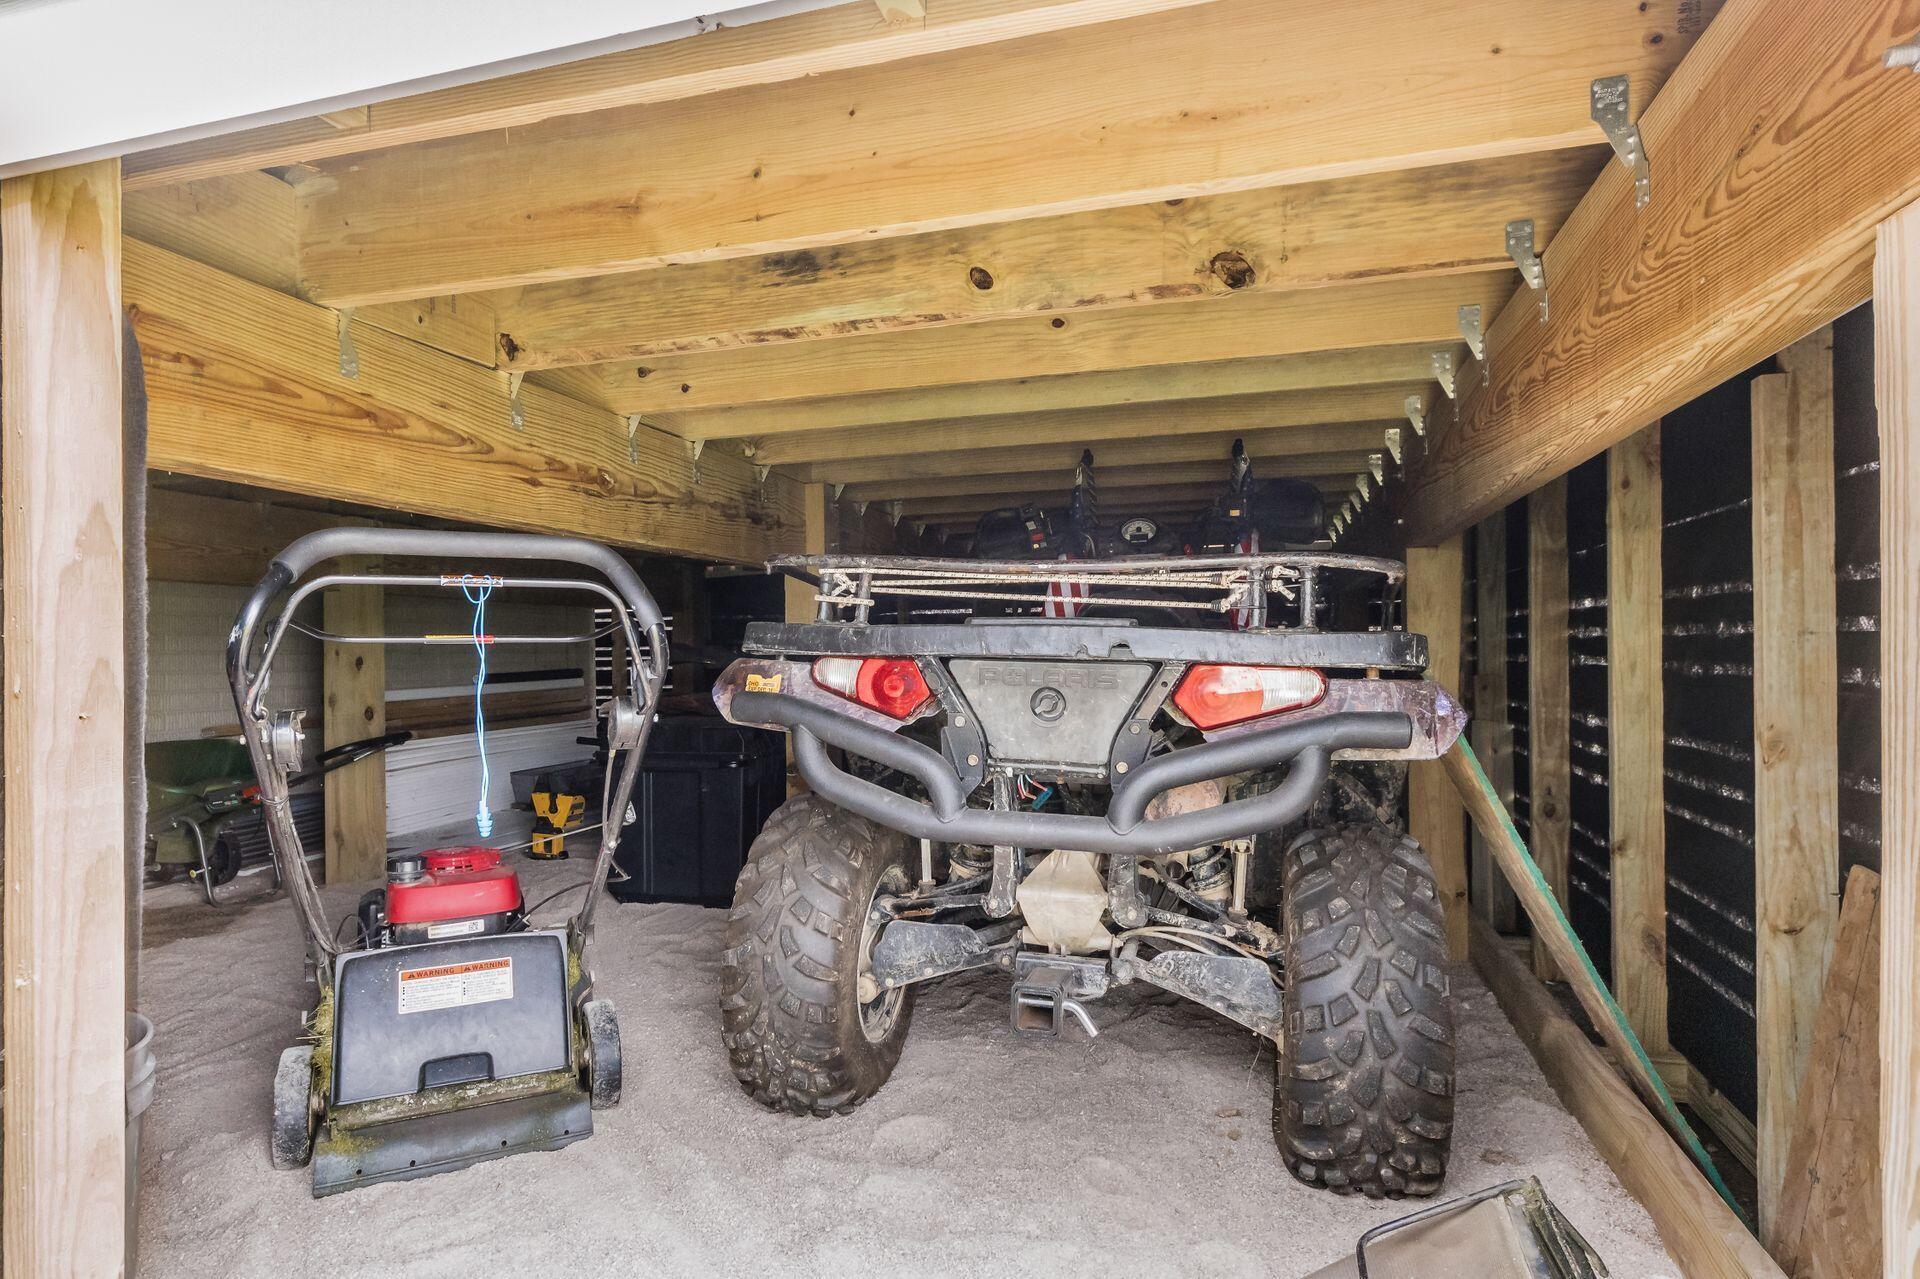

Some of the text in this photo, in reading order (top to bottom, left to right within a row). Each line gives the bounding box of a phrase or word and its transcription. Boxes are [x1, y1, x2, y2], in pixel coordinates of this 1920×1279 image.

[978, 667, 1120, 689] POLARIS
[472, 960, 509, 970] WARNING
[416, 967, 455, 978] WARNING
